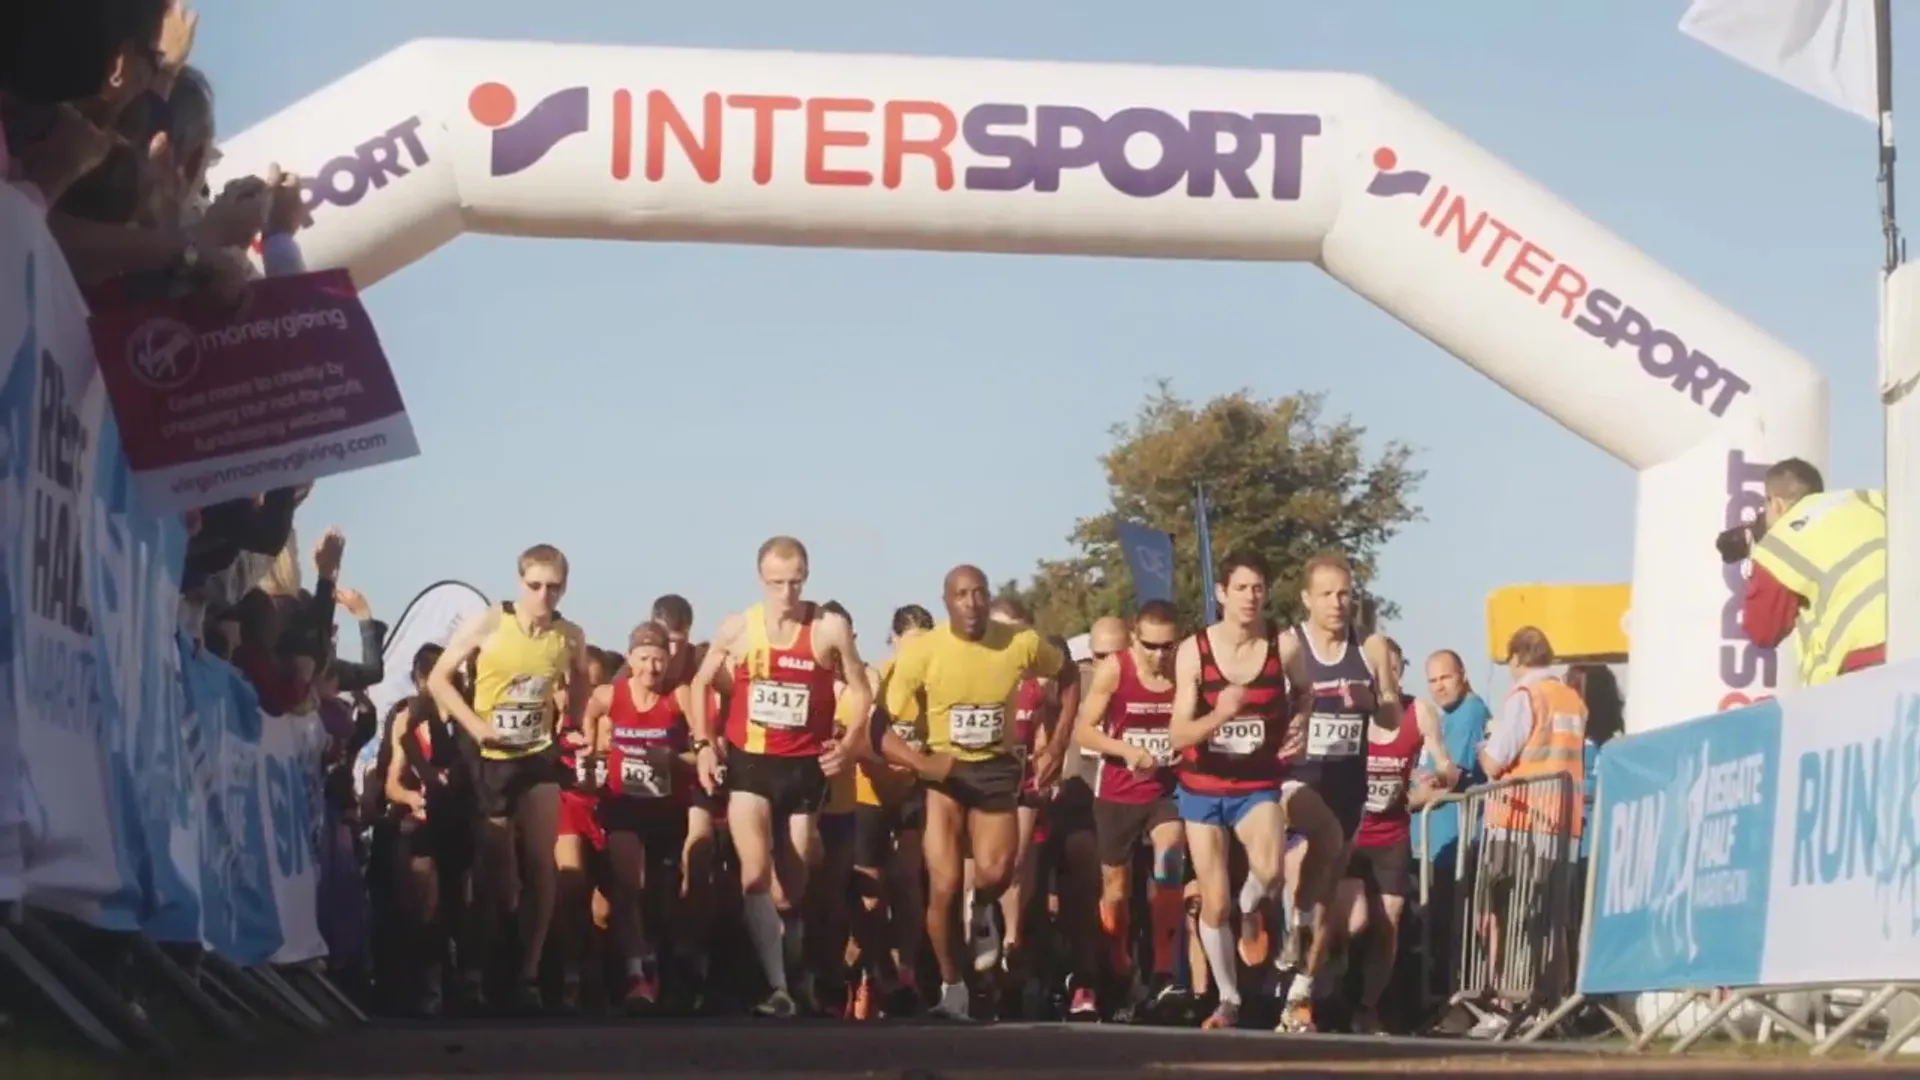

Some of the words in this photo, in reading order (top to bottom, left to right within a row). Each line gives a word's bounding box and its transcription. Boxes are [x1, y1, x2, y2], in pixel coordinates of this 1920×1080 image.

[611, 88, 1321, 201] INTERSPORT
[1418, 184, 1752, 418] INTERSPORT
[496, 711, 543, 730] 1149
[754, 687, 806, 709] 3417
[953, 711, 1004, 729] 3425
[1313, 722, 1361, 740] 1708
[1790, 737, 1881, 887] RUN
[1602, 790, 1665, 917] RUN
